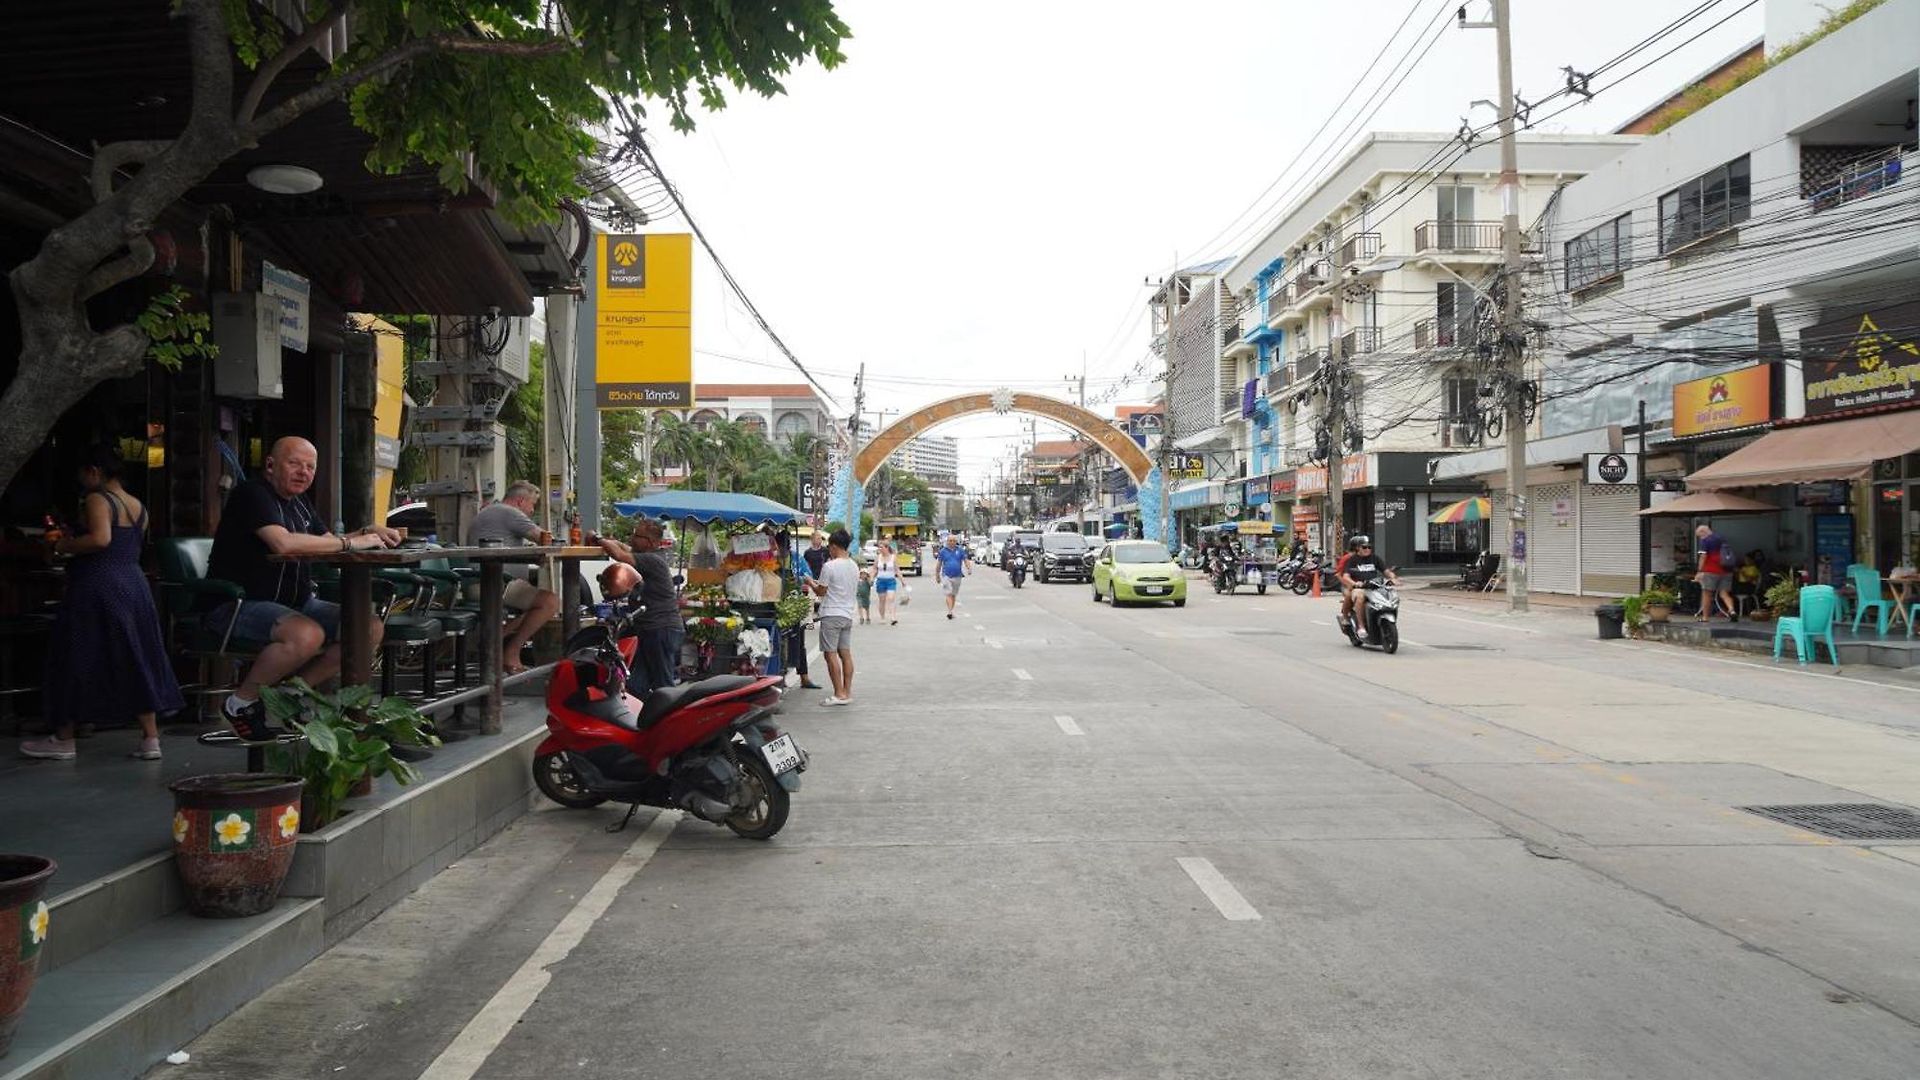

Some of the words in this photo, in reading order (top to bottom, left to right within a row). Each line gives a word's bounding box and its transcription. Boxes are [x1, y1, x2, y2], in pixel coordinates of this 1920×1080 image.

[605, 314, 646, 325] krungsri
[605, 338, 644, 348] exchange
[1834, 398, 1855, 407] Relax
[1856, 393, 1880, 404] Health
[1881, 388, 1915, 398] Massage
[1385, 510, 1396, 519] UP
